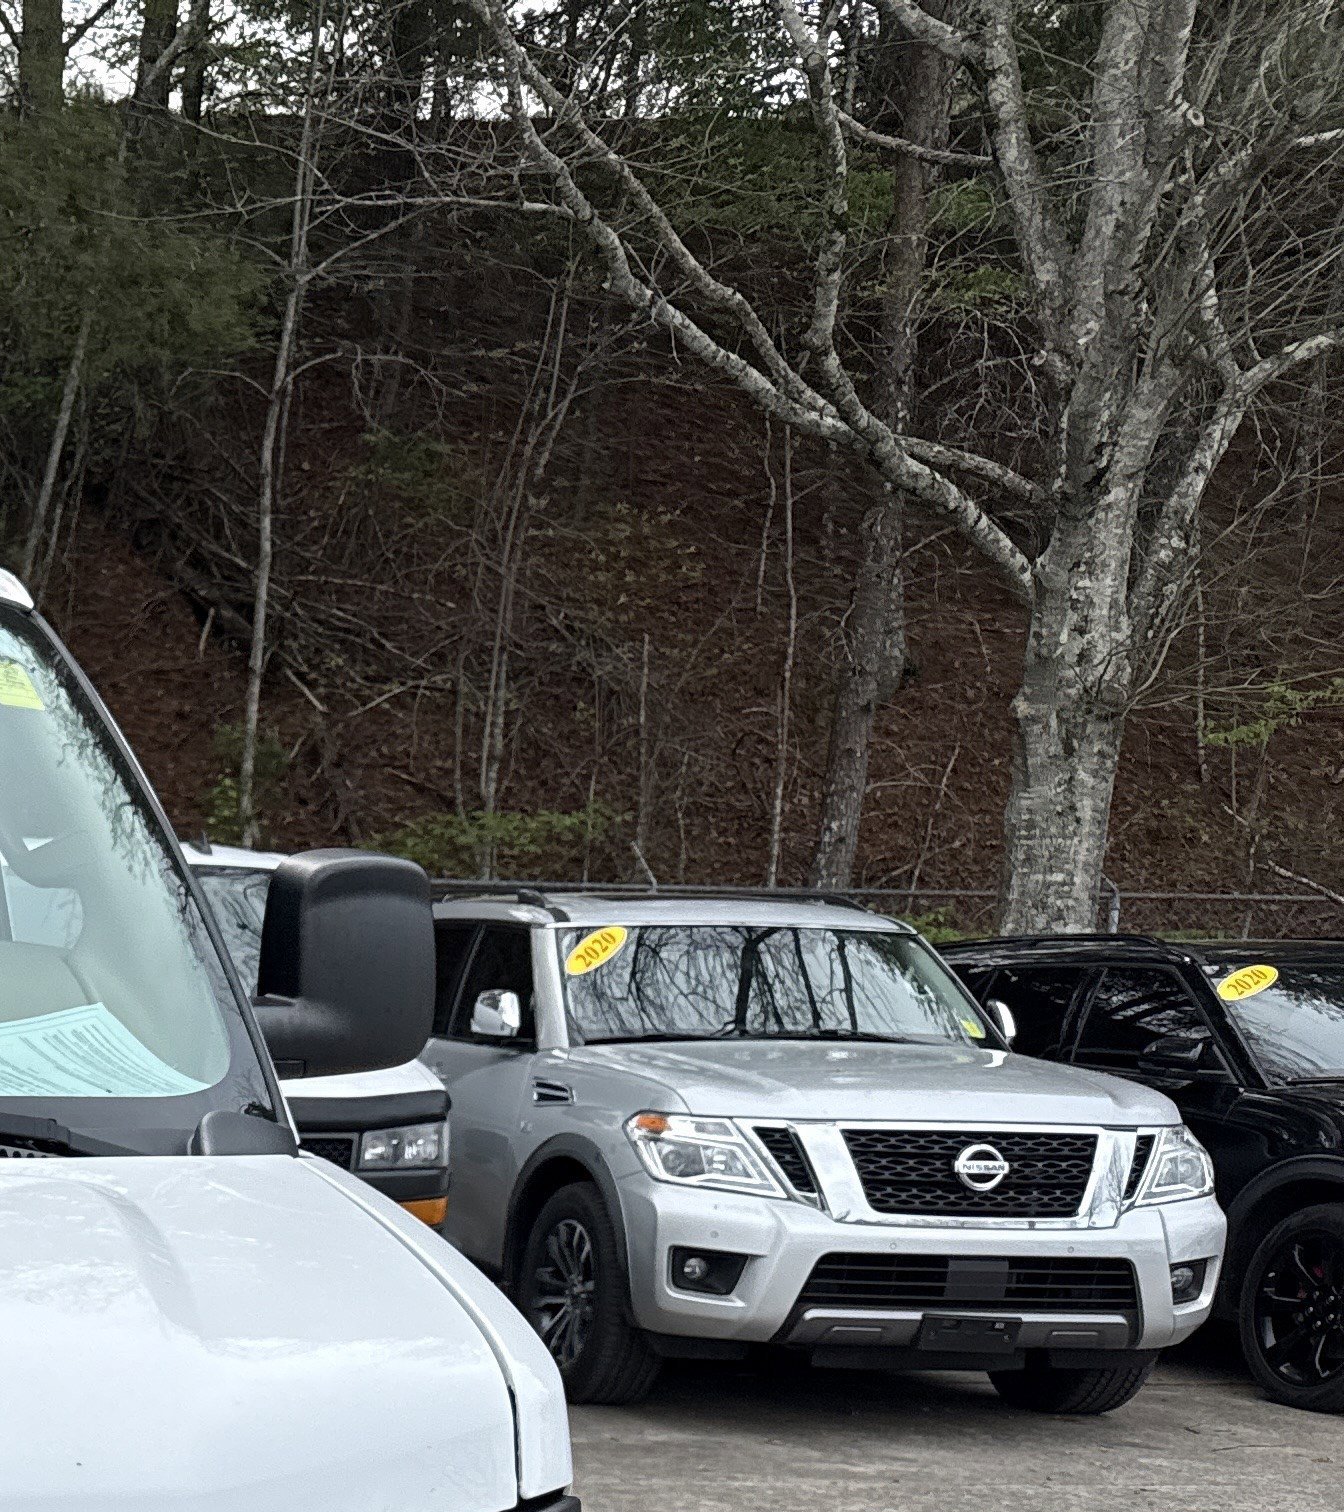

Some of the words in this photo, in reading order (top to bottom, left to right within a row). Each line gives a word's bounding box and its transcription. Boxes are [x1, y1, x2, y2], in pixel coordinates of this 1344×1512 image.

[574, 932, 616, 967] 2020
[1226, 968, 1268, 996] 2020
[962, 1163, 1005, 1172] NISSAN
